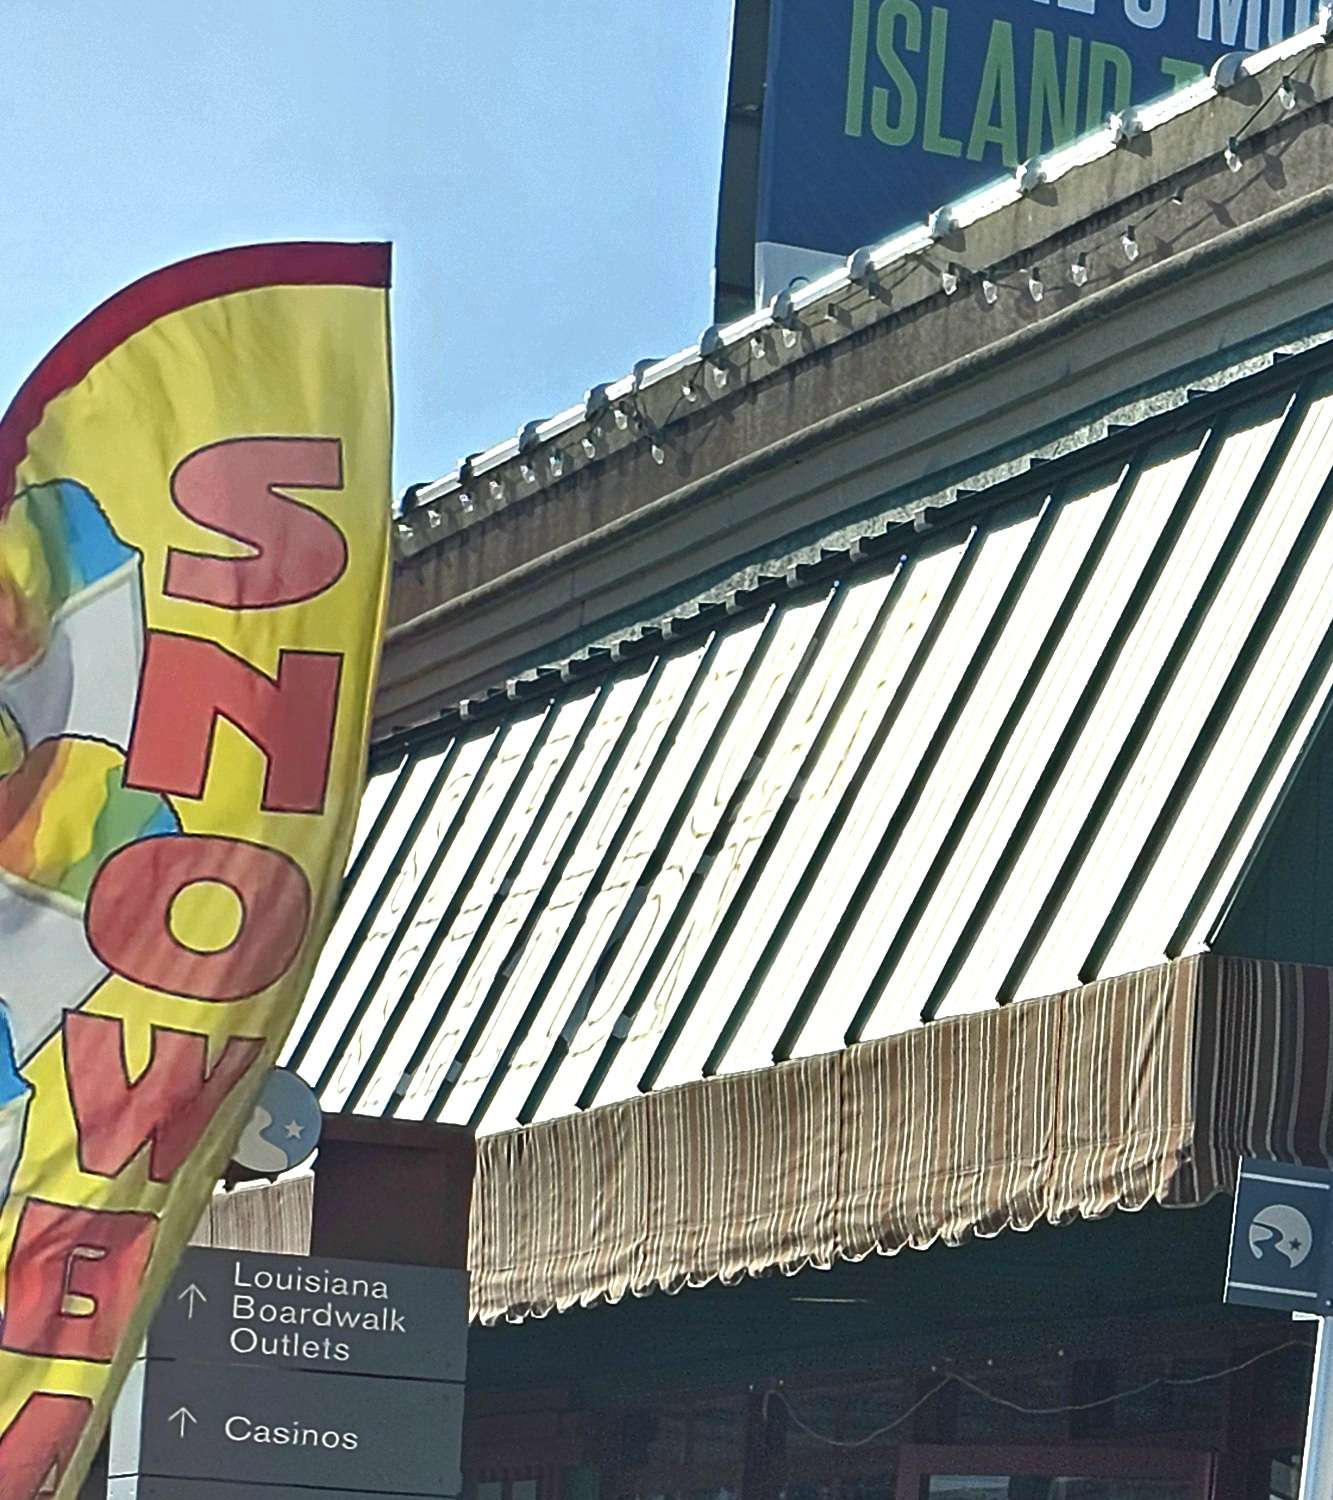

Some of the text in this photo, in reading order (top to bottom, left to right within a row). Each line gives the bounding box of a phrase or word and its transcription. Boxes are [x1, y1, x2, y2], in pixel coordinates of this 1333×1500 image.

[845, 0, 1133, 167] ISLAND
[234, 1261, 389, 1299] Louisiana
[232, 1295, 407, 1333] Boardwalk
[230, 1328, 350, 1362] Outlets
[224, 1416, 359, 1451] Casinos
